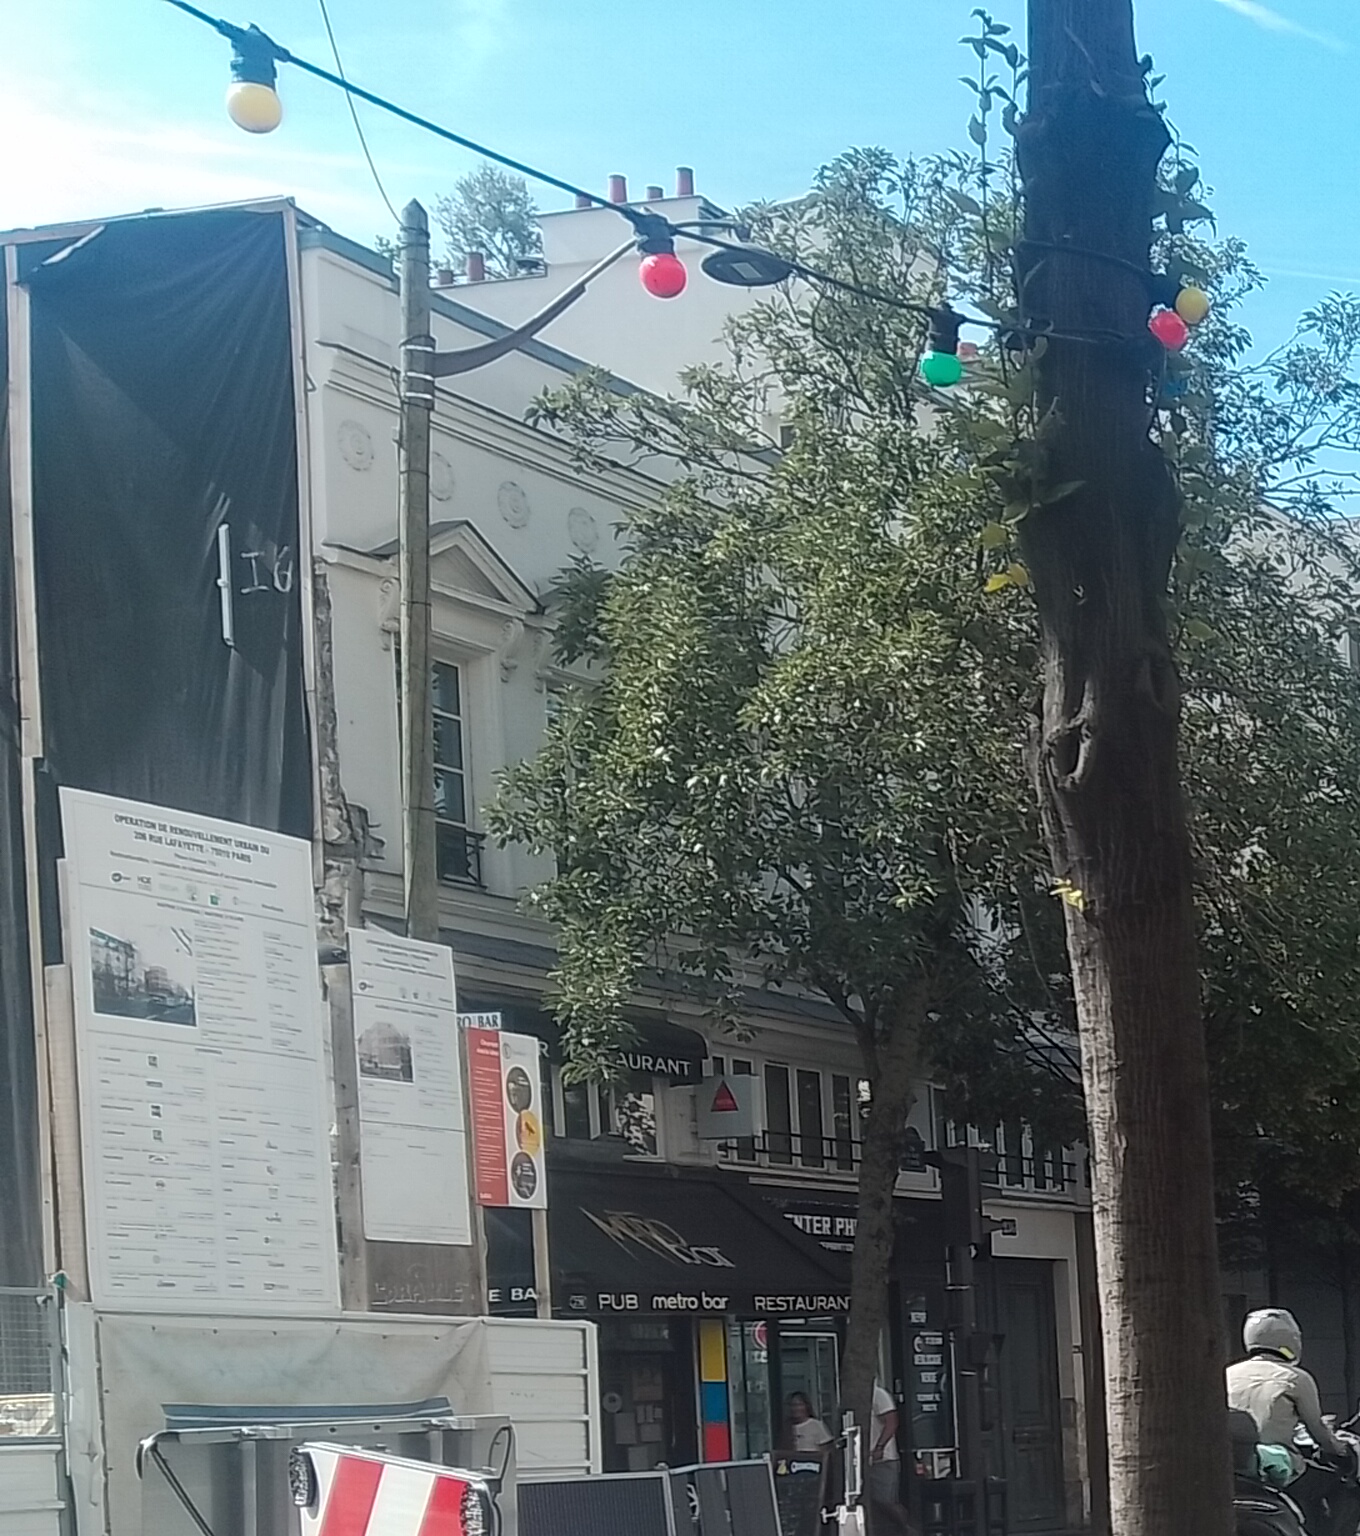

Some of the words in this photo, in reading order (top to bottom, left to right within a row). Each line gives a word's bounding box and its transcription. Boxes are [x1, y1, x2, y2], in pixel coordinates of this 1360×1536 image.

[114, 813, 157, 831] OPERATION
[157, 822, 168, 833] DE
[169, 825, 233, 848] RENOUVELLEMENT
[234, 839, 259, 853] URBAIN
[260, 844, 270, 855] DU
[148, 834, 164, 845] RUE
[164, 837, 205, 854] LAFAYETTE
[231, 850, 252, 864] PARIS
[477, 1014, 499, 1028] BAR
[617, 1052, 692, 1077] AURANT
[783, 1213, 832, 1236] NTER
[597, 1293, 640, 1311] PUB
[652, 1292, 699, 1311] metro
[701, 1290, 730, 1311] bar
[754, 1294, 852, 1312] RESTAURAN
